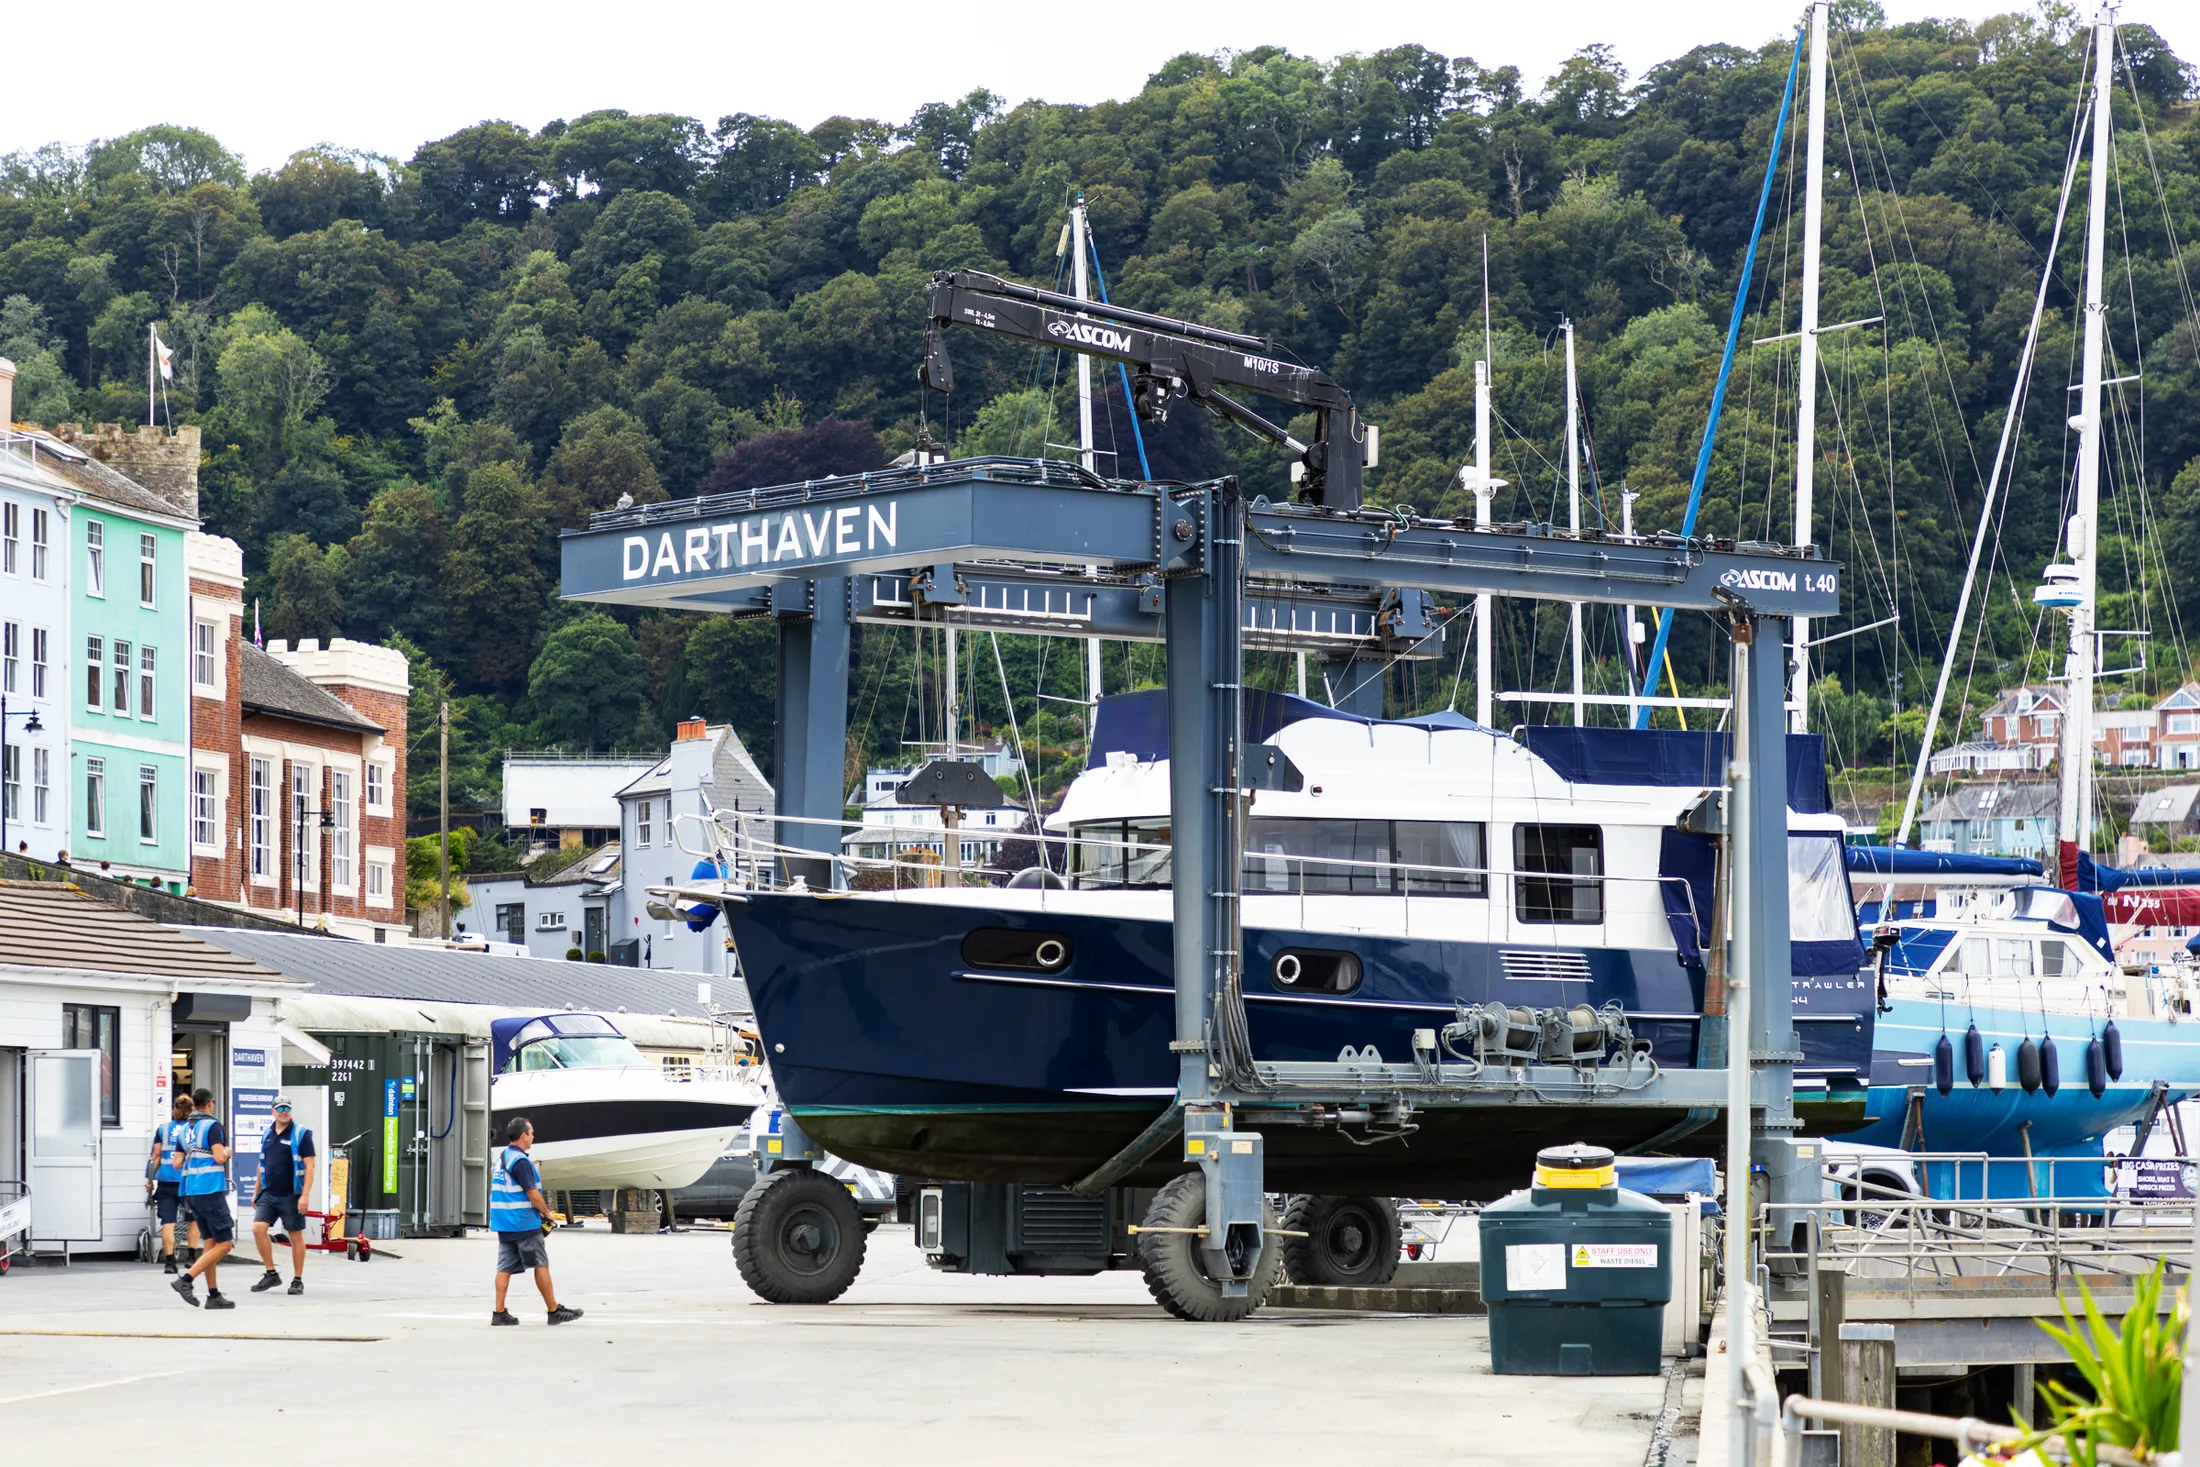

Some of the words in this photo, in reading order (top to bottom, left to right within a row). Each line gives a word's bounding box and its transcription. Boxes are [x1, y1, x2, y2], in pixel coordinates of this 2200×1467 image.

[1066, 322, 1132, 353] ASCOM
[1243, 355, 1280, 374] M10/1S
[622, 501, 897, 581] DARTHAVEN
[1737, 569, 1797, 592] ASCOM
[1805, 574, 1836, 593] t.40
[1791, 981, 1866, 989] TRAWLER
[234, 1051, 265, 1064] DARTHAVEN
[331, 1059, 365, 1070] 397442
[387, 1088, 396, 1116] dainton
[386, 1119, 395, 1153] Portable
[385, 1154, 396, 1191] Buildings
[2121, 1161, 2135, 1171] BIG
[2155, 1161, 2180, 1171] PRIZES
[2158, 1184, 2176, 1192] PRIZES
[1591, 1247, 1616, 1255] STAFF
[1617, 1247, 1633, 1255] USE
[1634, 1247, 1653, 1255] ONLY
